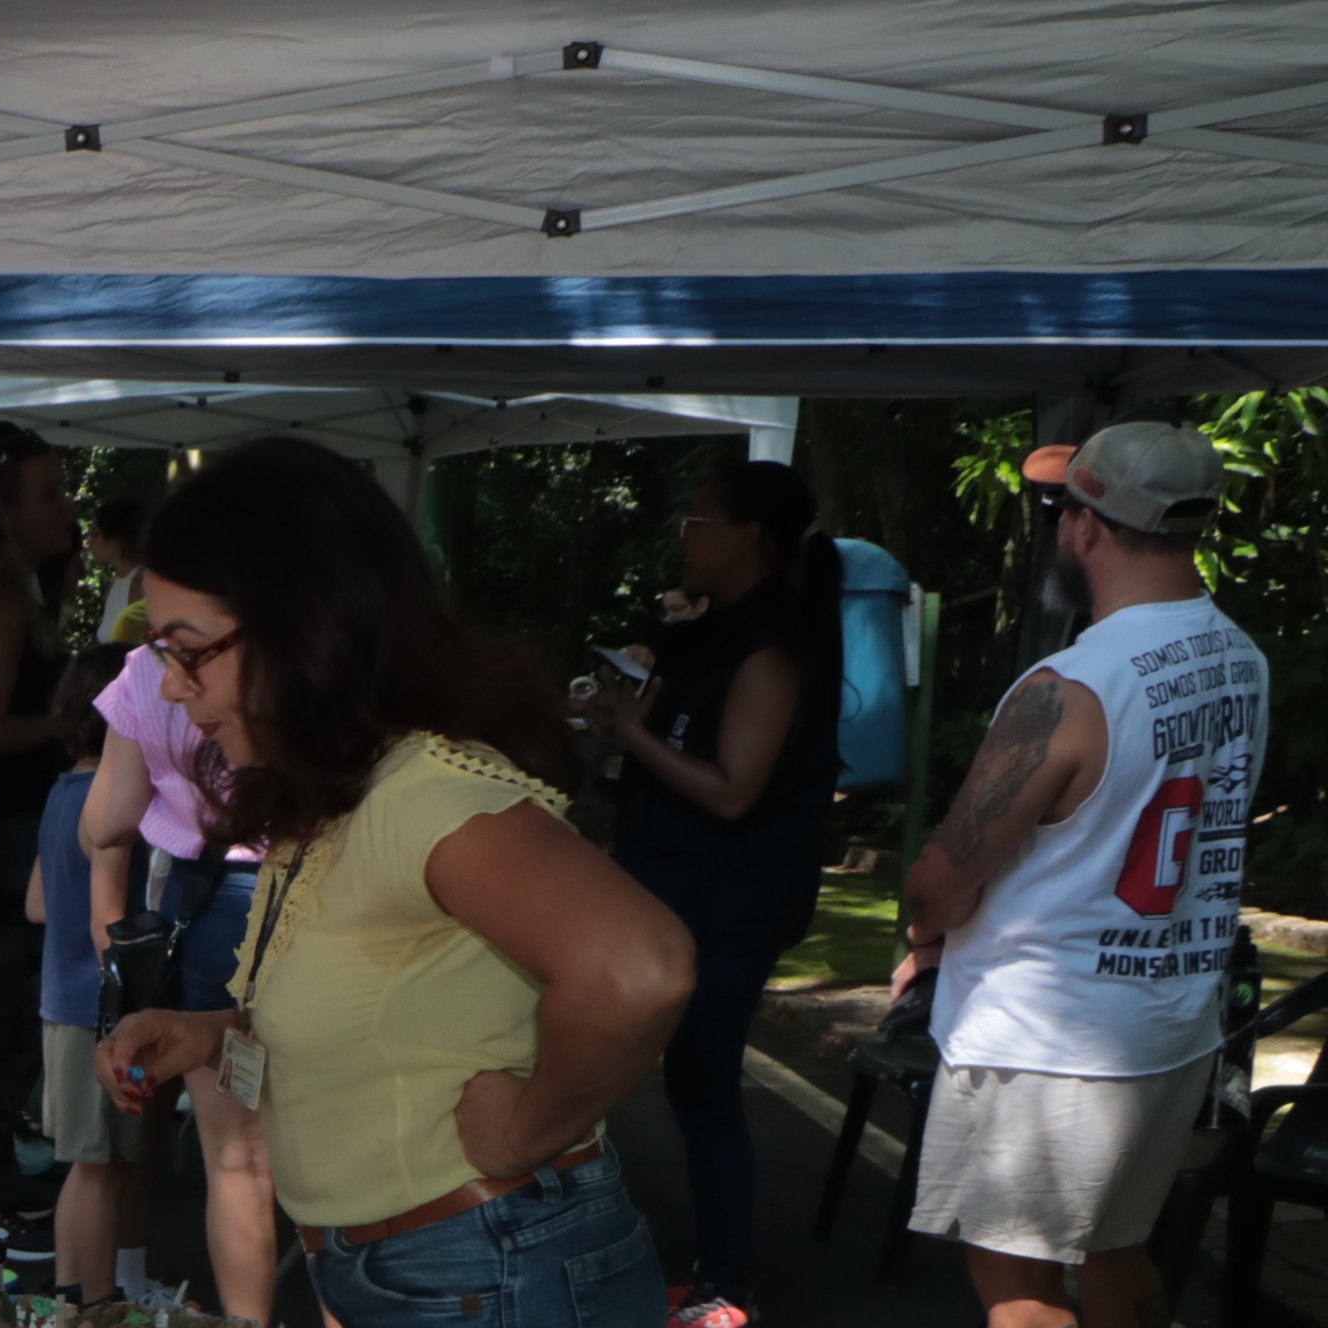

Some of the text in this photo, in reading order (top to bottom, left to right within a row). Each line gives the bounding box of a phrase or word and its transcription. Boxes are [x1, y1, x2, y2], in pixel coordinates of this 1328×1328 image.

[1130, 640, 1189, 677] SOMOS
[1145, 672, 1196, 709] SOMOS
[1203, 798, 1247, 828] WORL
